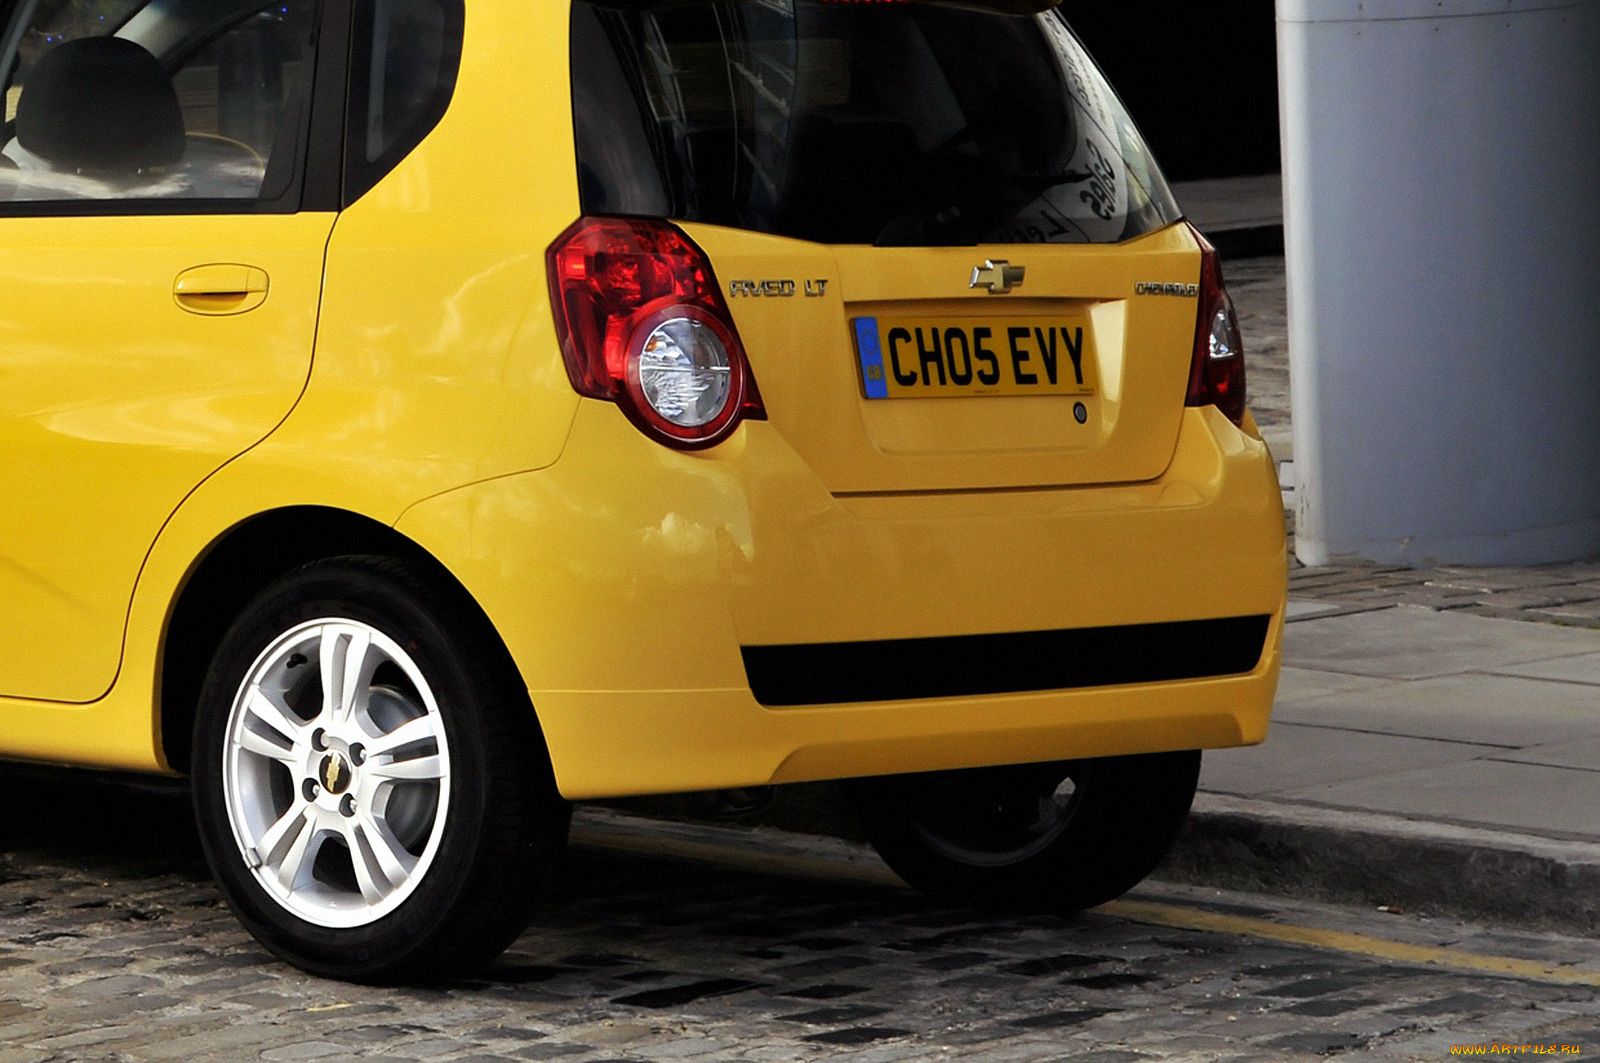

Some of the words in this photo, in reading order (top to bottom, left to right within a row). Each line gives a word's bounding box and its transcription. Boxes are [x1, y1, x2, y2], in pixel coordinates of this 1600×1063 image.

[729, 279, 795, 297] AVEO
[804, 279, 828, 296] LT
[1007, 326, 1084, 385] EVY
